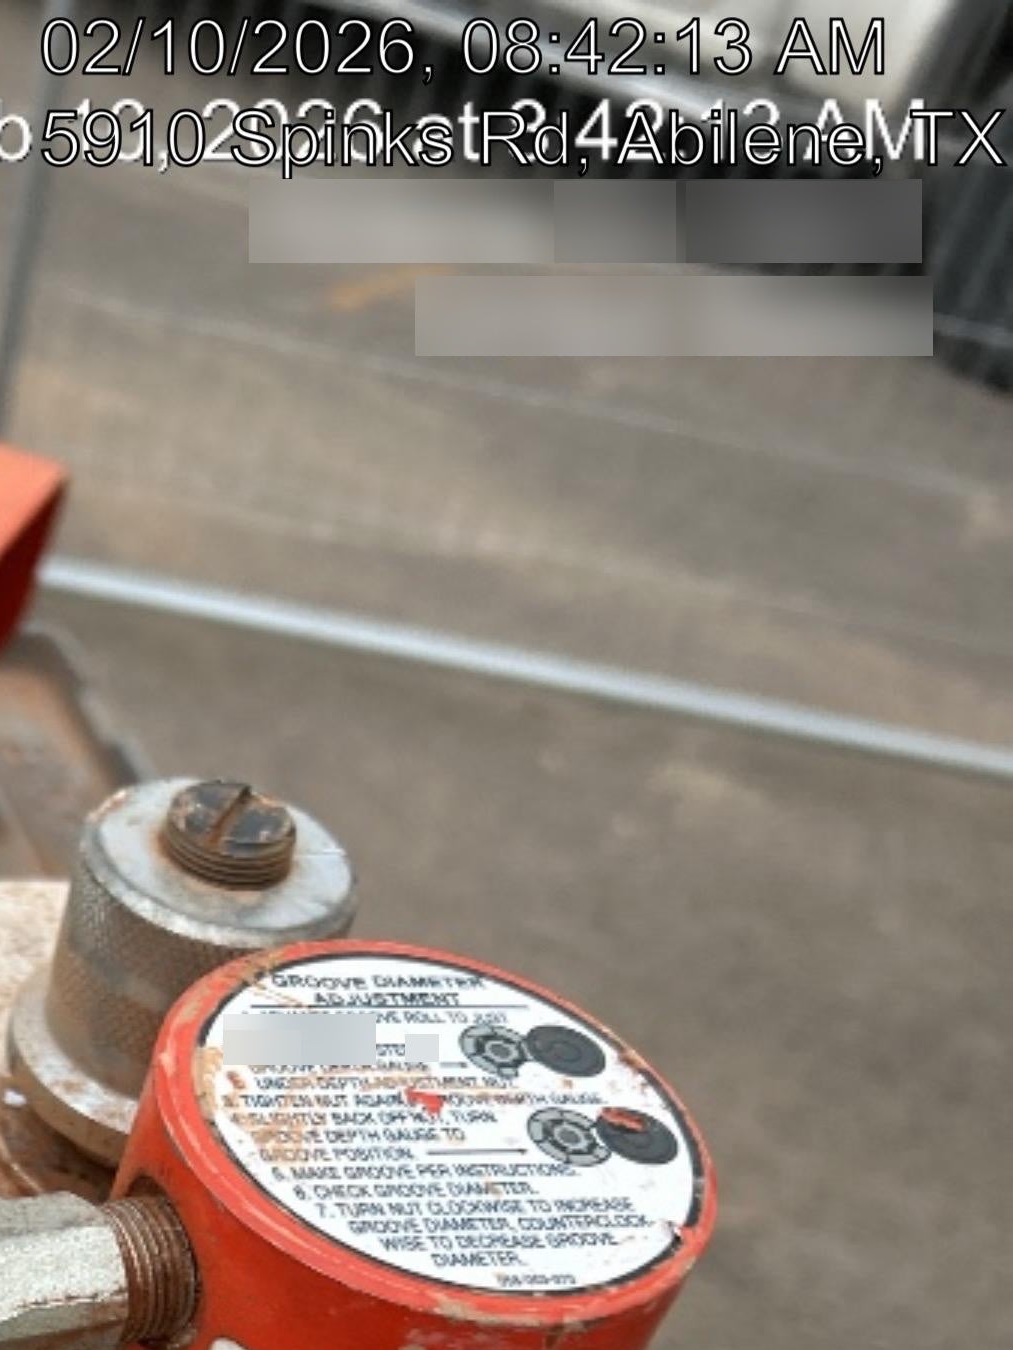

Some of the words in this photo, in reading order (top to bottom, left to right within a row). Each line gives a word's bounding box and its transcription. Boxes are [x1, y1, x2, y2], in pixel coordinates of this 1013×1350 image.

[272, 974, 368, 991] GROOVE
[372, 974, 487, 991] DIAMETER
[313, 991, 461, 1006] ADJUSTMENT
[240, 1094, 313, 1108] TIGHTEN
[315, 1094, 349, 1108] NUT
[330, 1112, 376, 1126] BACK
[325, 1129, 380, 1144] DEPTH
[382, 1128, 440, 1143] GAUGE
[441, 1126, 466, 1141] TO
[258, 1148, 331, 1162] GROOVE
[290, 1165, 341, 1180] MAKE
[343, 1164, 415, 1180] GROOVE
[415, 1163, 450, 1177] PER
[313, 1184, 373, 1198] CHECK
[373, 1183, 446, 1198] GROOVE
[335, 1202, 386, 1218] TURN
[388, 1202, 423, 1216] NUT
[427, 1199, 526, 1215] CLOCKWISE
[528, 1198, 553, 1213] TO
[554, 1196, 636, 1212] INCREASE
[348, 1220, 422, 1234] GROOVE
[379, 1237, 426, 1251] WISE
[427, 1236, 453, 1250] TO
[454, 1233, 546, 1249] DECREASE
[548, 1231, 619, 1247] GROOVE
